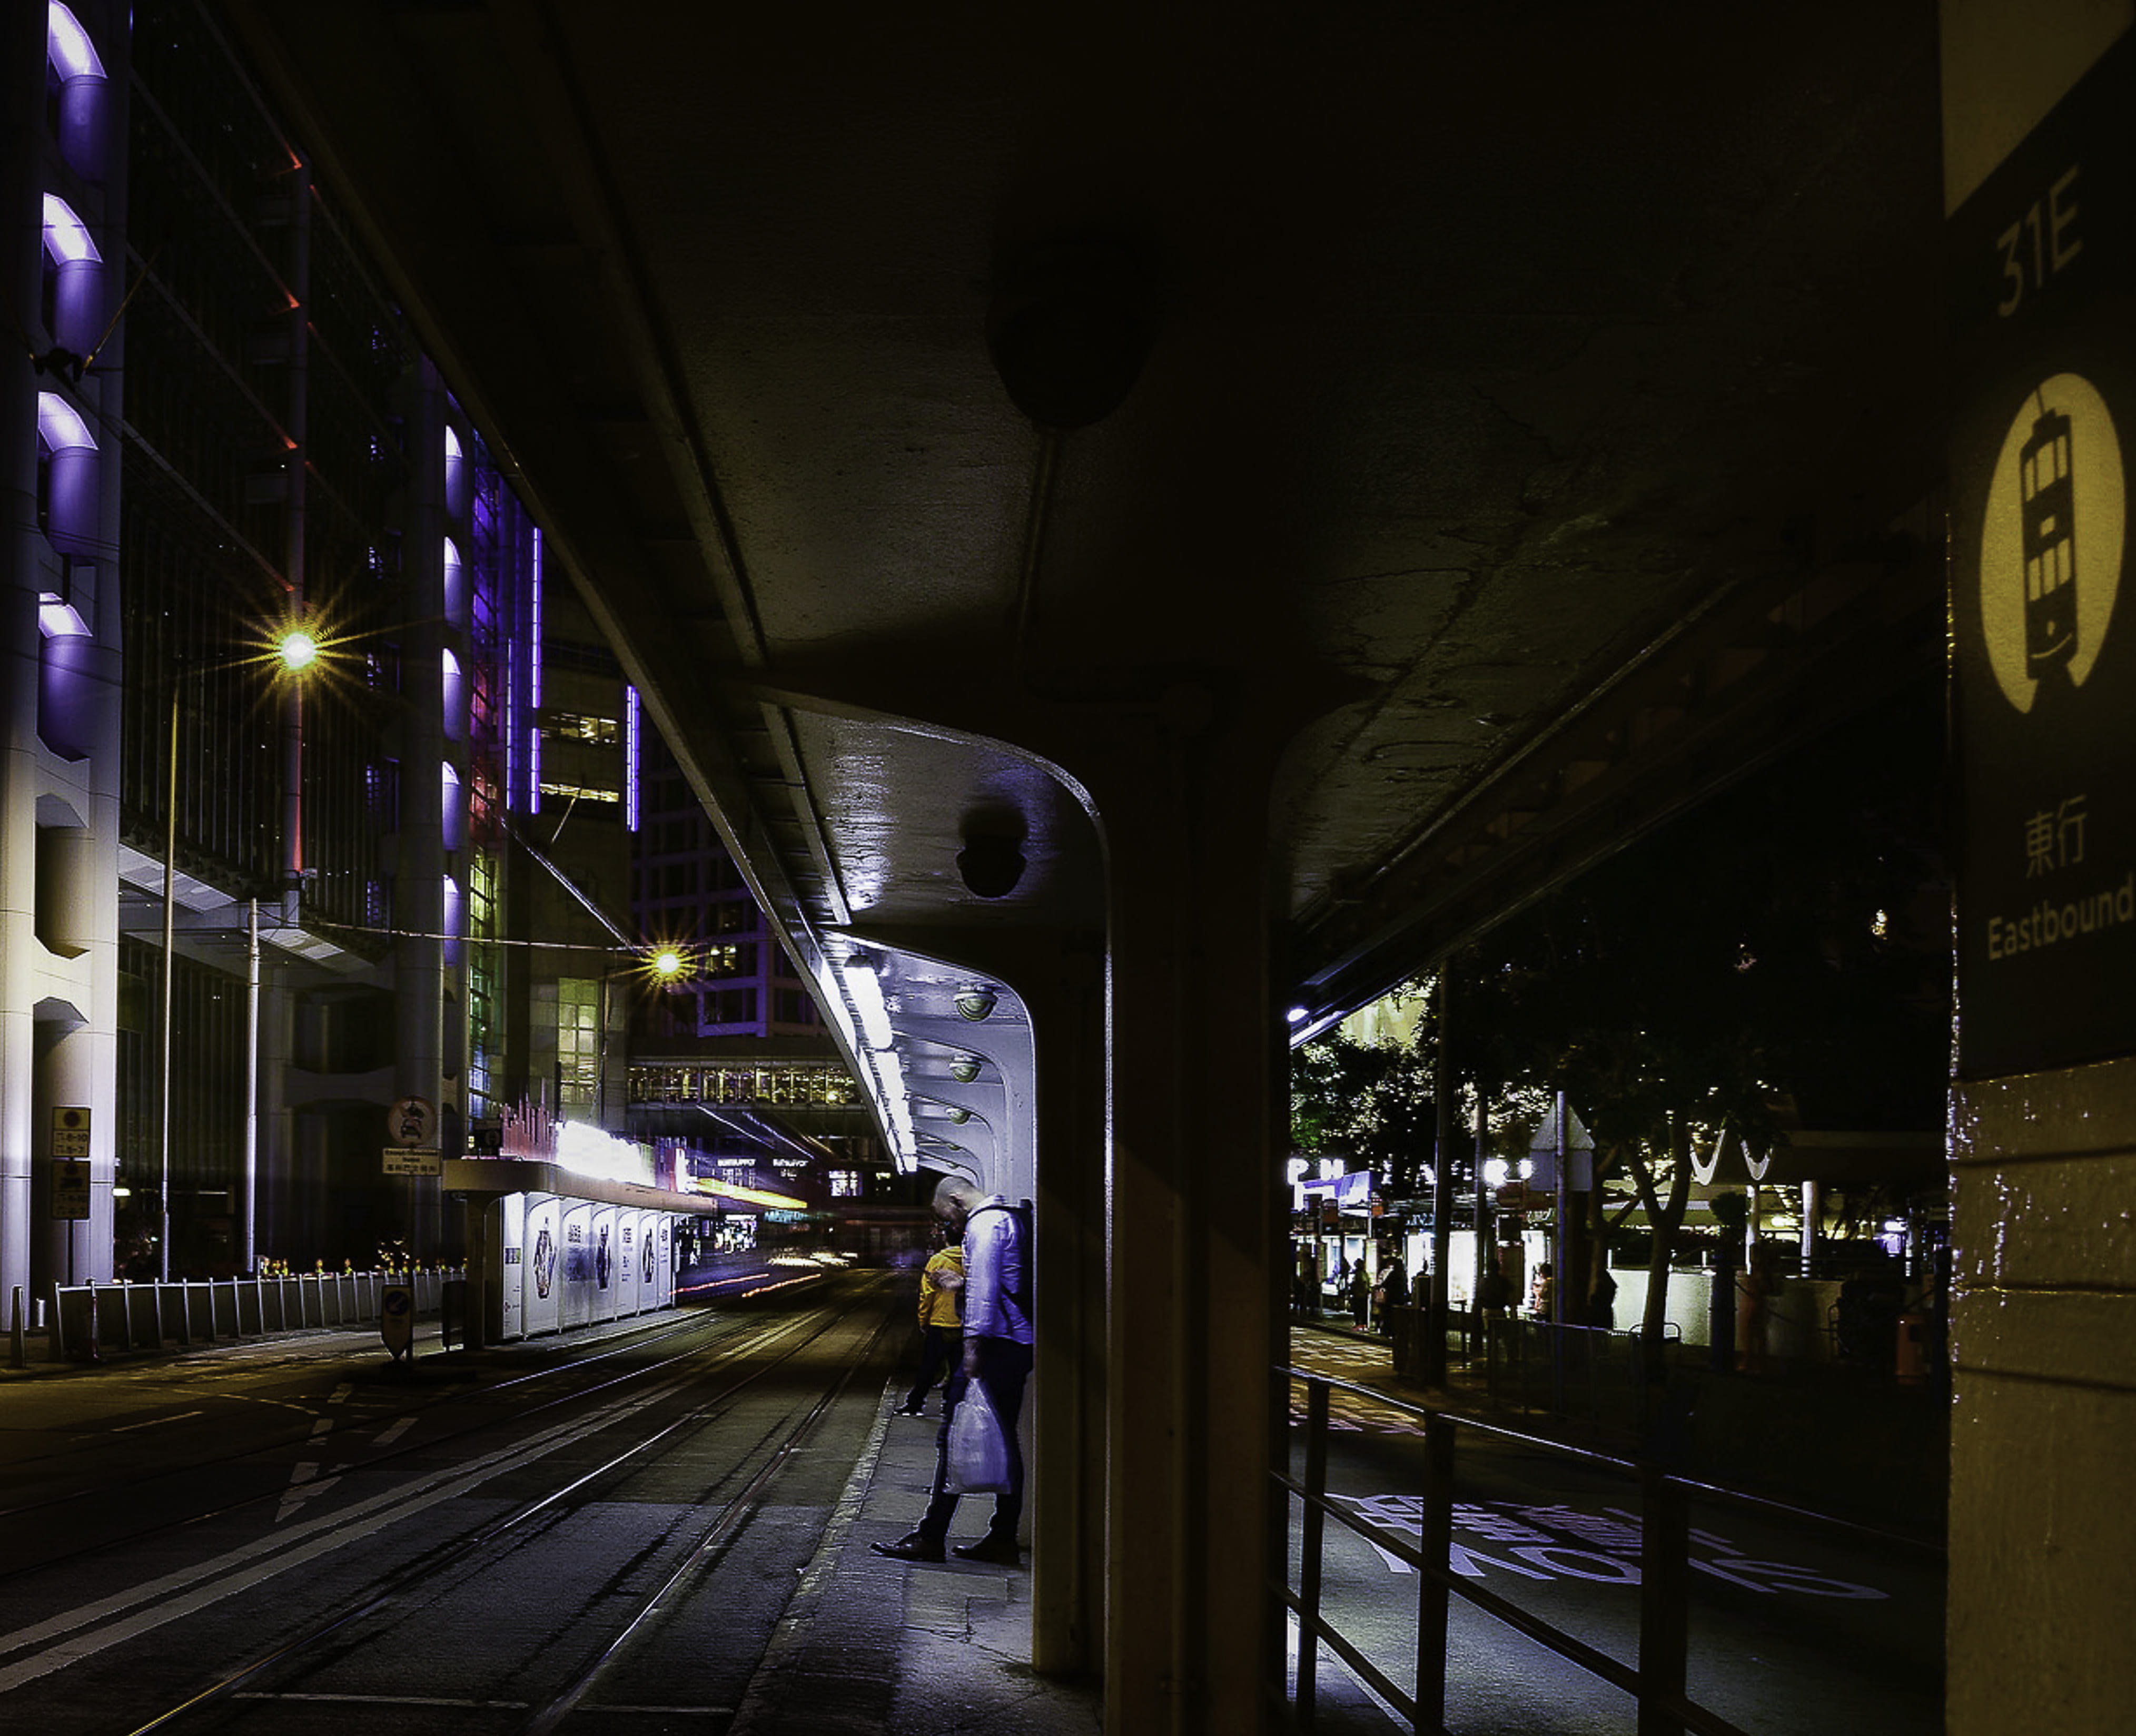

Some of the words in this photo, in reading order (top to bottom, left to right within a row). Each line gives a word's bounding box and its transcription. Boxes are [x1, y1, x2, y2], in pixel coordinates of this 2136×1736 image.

[1995, 162, 2084, 319] 31E
[2023, 793, 2089, 880] 東行
[1986, 870, 2135, 962] Eastbound
